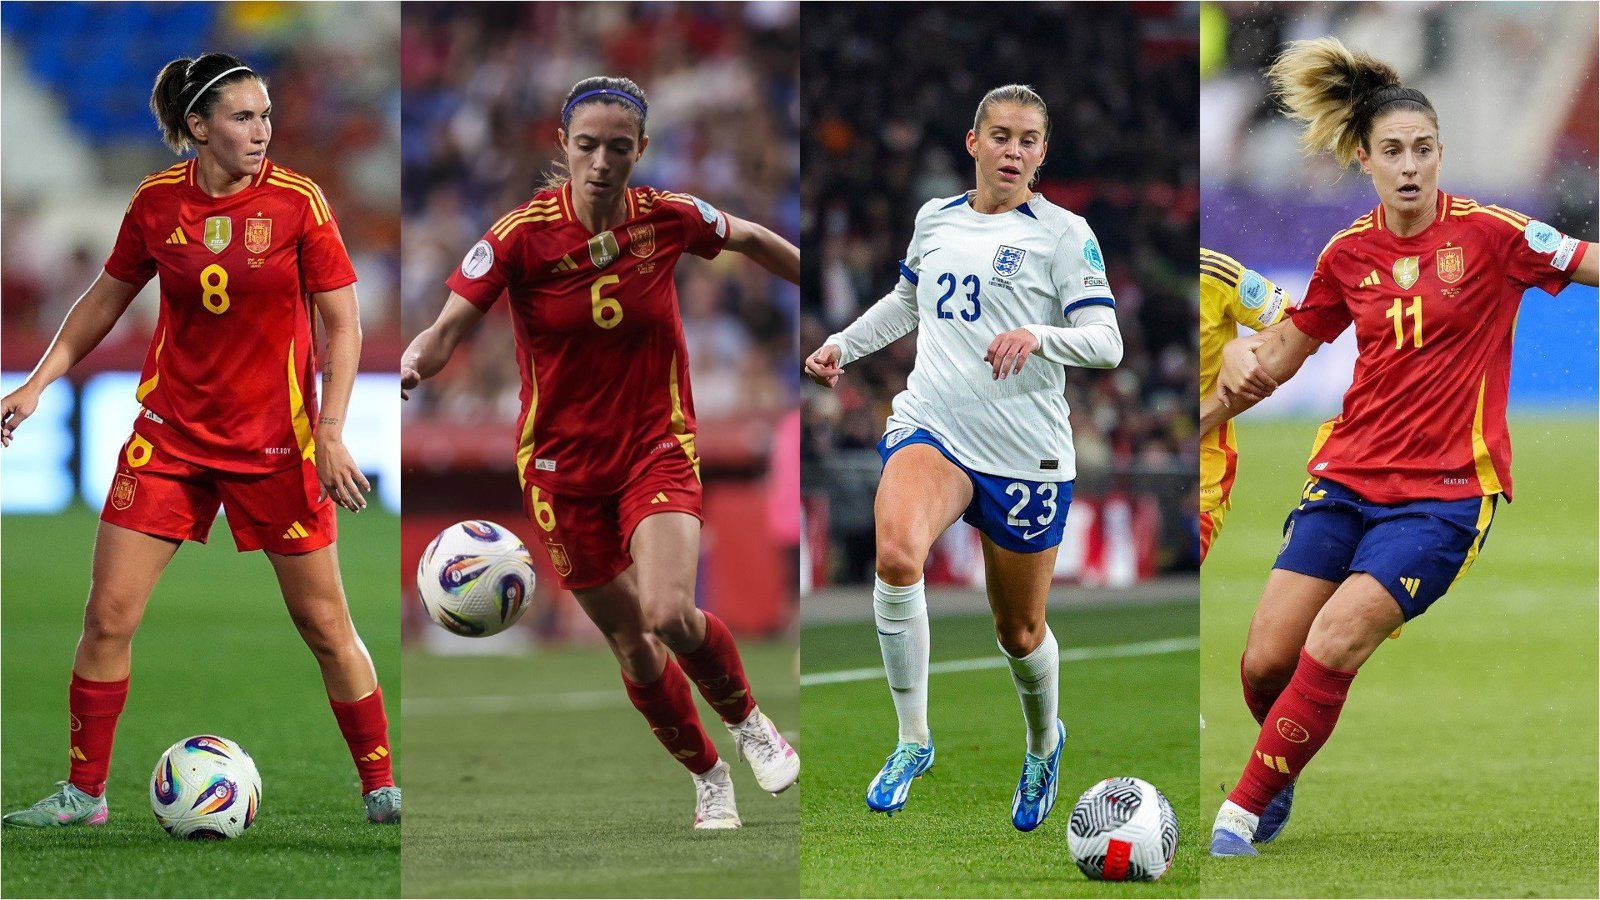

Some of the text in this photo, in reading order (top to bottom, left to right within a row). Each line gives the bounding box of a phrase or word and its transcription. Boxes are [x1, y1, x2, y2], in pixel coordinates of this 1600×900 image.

[200, 264, 230, 314] 8
[591, 275, 623, 329] 6
[936, 272, 981, 322] 23
[1386, 296, 1423, 350] 11
[531, 485, 556, 532] 6
[1005, 482, 1058, 527] 23
